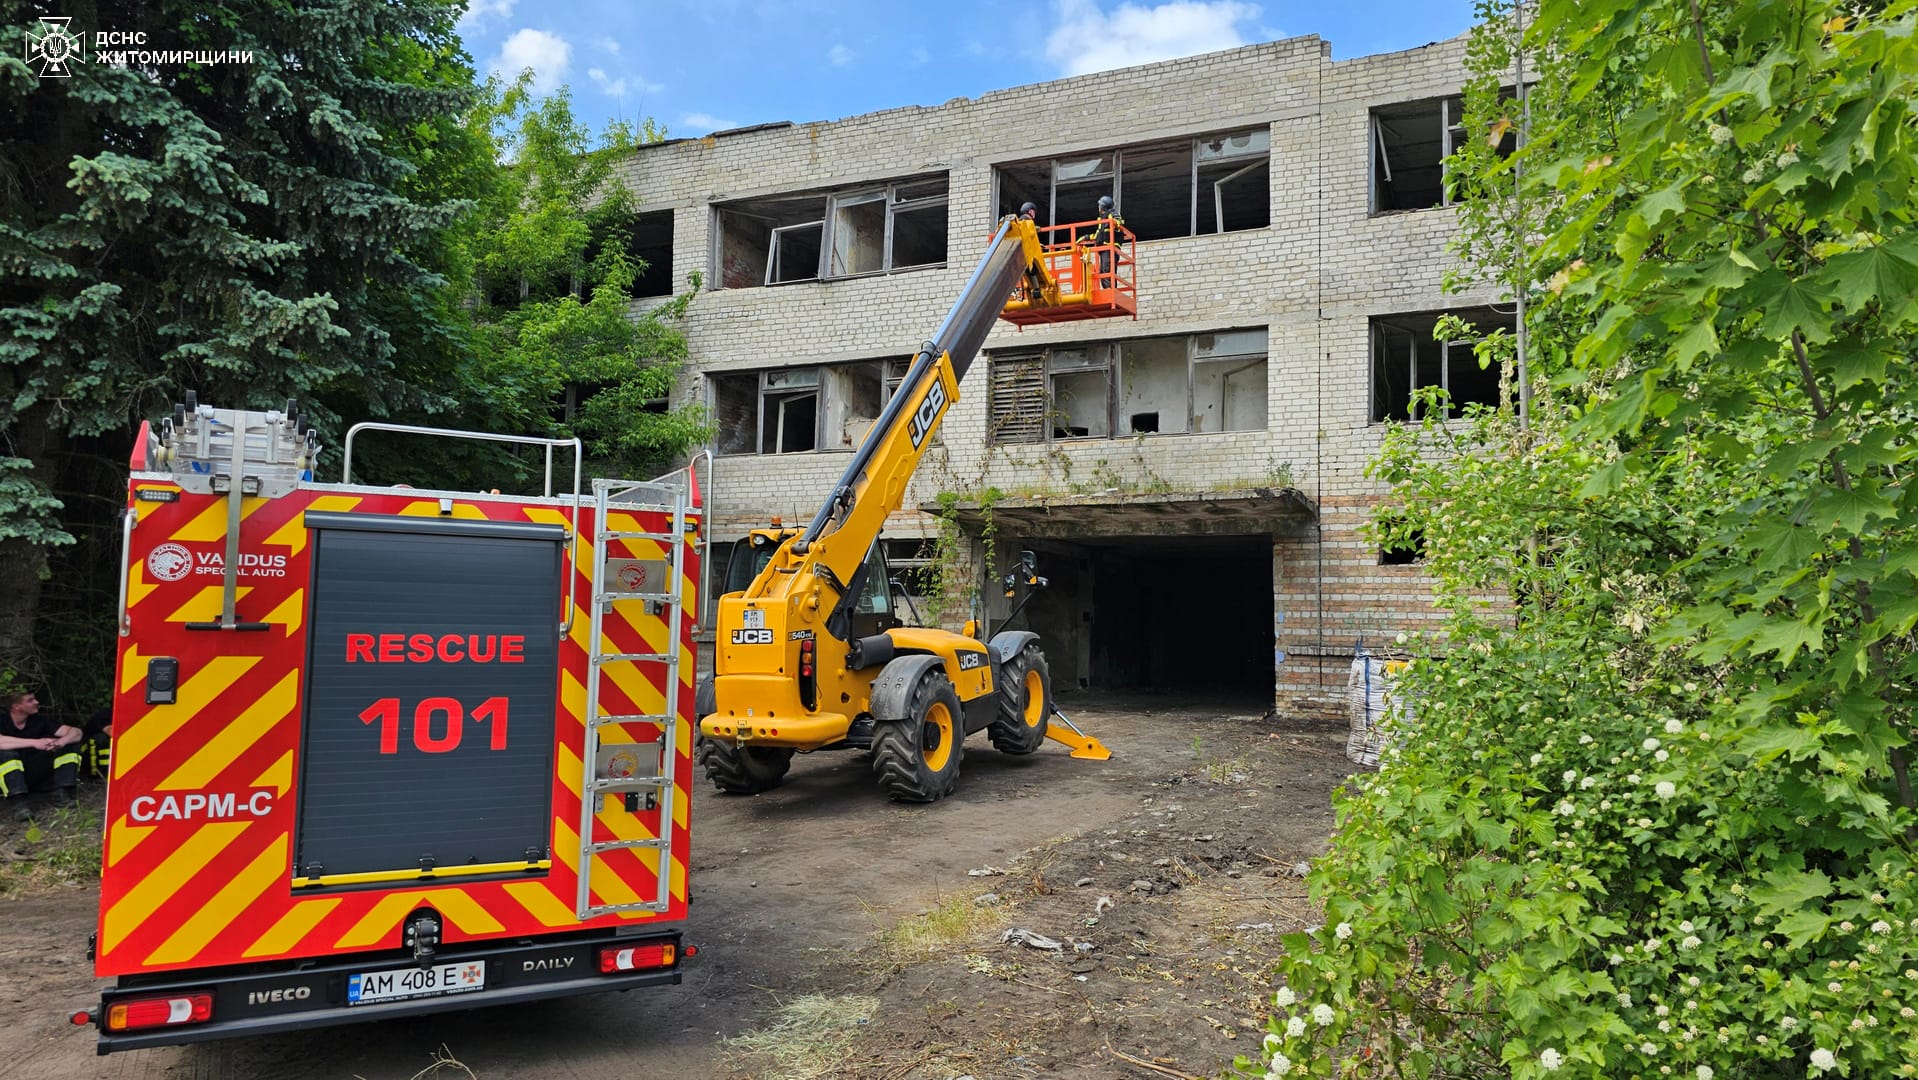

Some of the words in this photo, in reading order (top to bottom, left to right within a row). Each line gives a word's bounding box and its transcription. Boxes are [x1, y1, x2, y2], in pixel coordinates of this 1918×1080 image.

[913, 380, 944, 446] JCB
[196, 552, 286, 567] VAIDUS
[252, 568, 286, 577] AUTO
[732, 630, 773, 644] JCB
[345, 633, 525, 663] RESCUE
[960, 653, 979, 670] JCB
[358, 696, 509, 754] 101
[523, 956, 575, 972] DAILY
[362, 974, 394, 996] AM
[401, 969, 436, 991] 408
[444, 967, 457, 986] E
[248, 986, 311, 1005] IVECO
